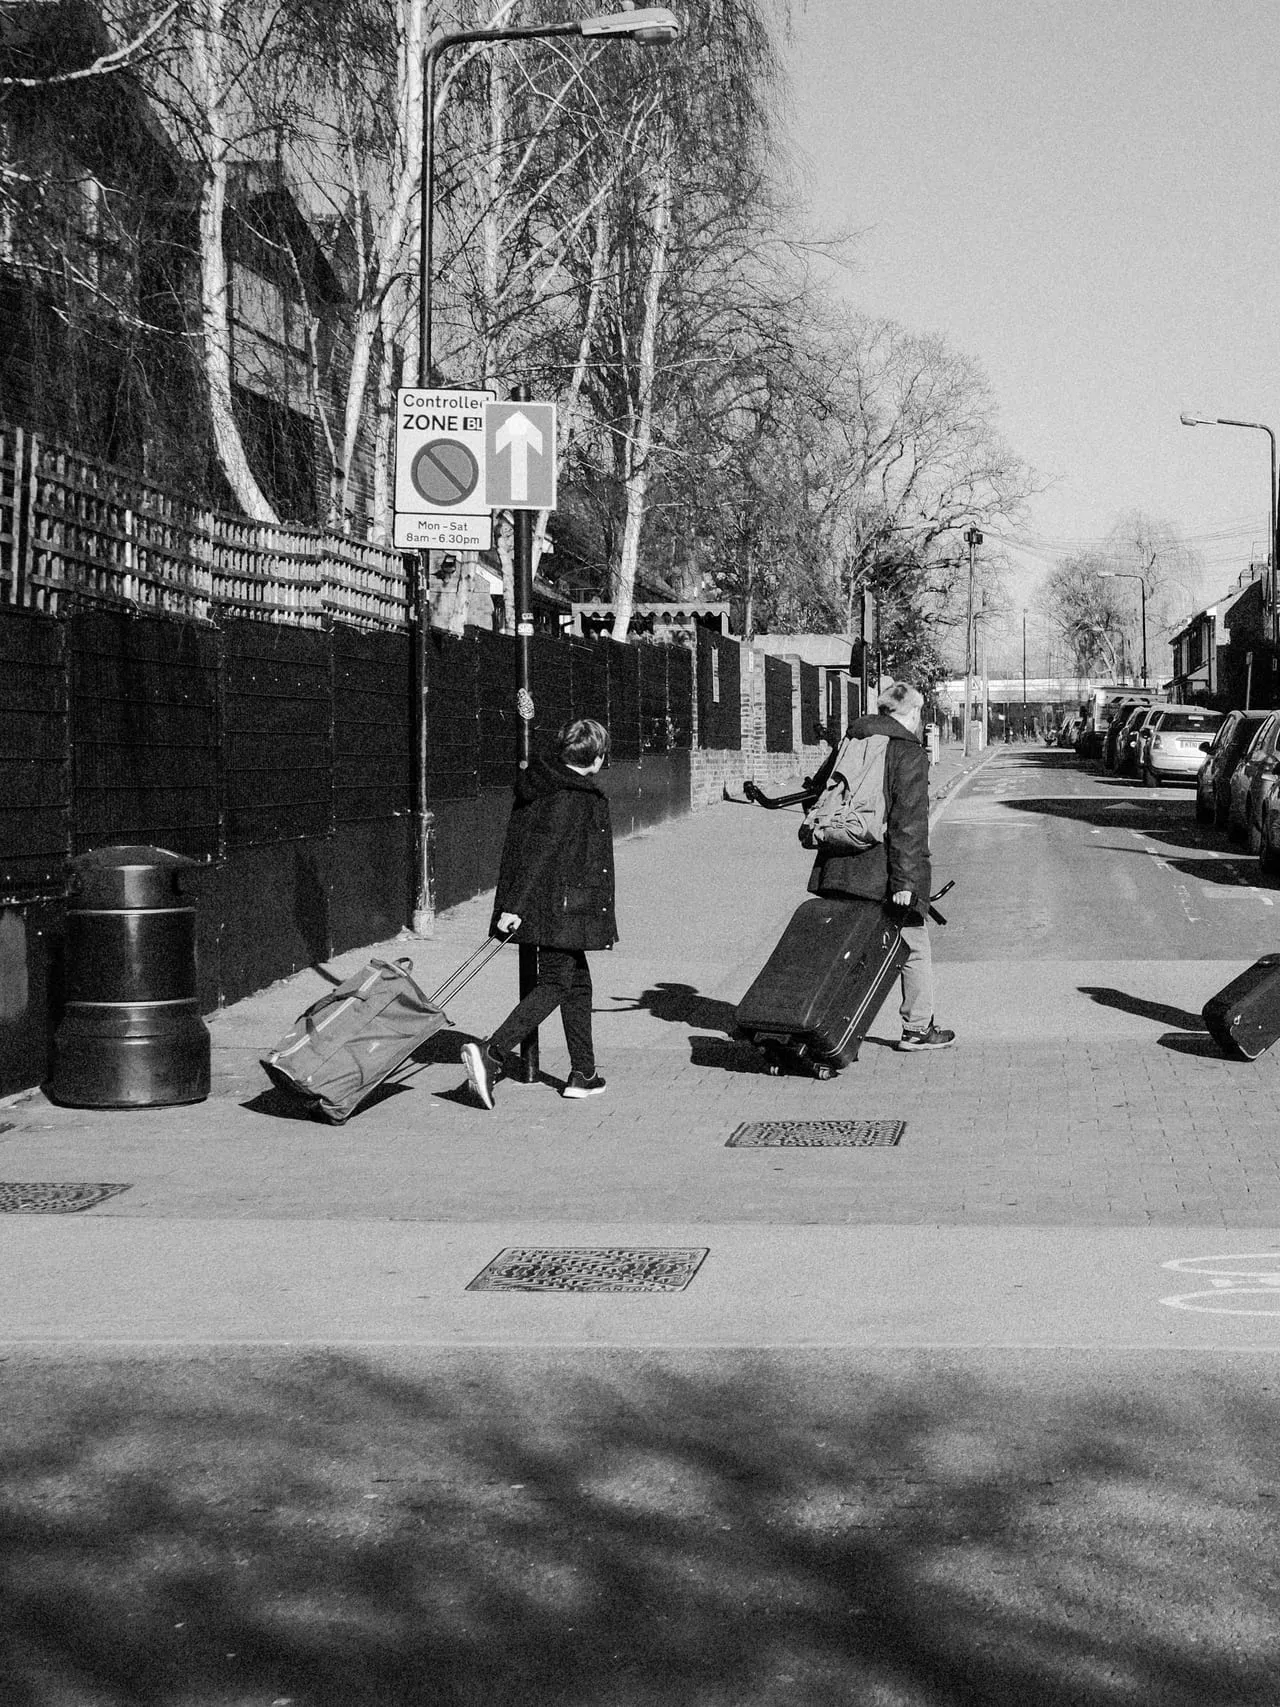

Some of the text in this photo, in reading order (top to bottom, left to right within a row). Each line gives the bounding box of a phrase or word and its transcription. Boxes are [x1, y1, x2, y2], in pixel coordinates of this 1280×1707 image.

[403, 394, 489, 409] Controlle
[403, 414, 458, 431] ZONE
[418, 520, 440, 531] Mon
[450, 521, 467, 531] Sat
[406, 534, 429, 542] 8am
[438, 534, 480, 544] 6.30pm
